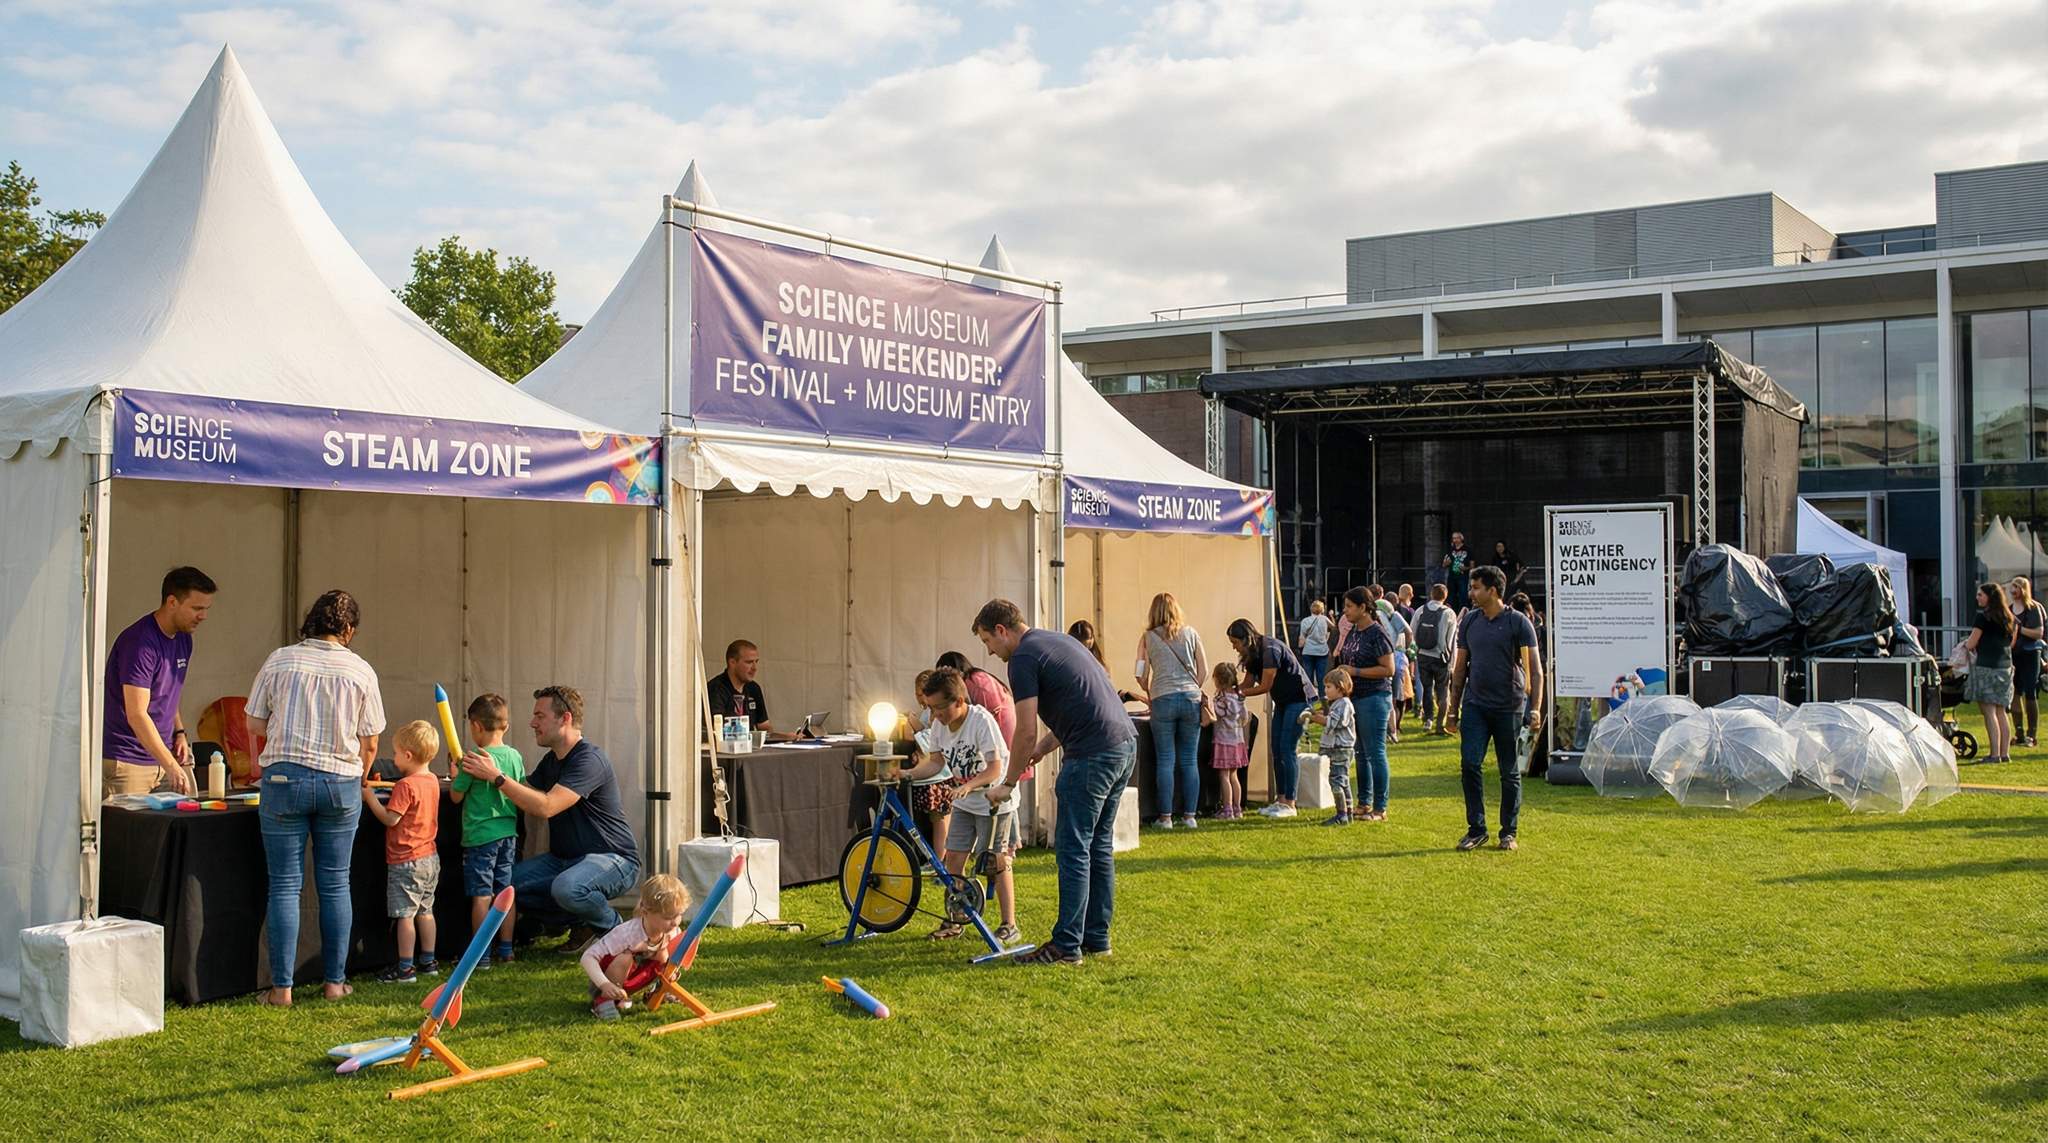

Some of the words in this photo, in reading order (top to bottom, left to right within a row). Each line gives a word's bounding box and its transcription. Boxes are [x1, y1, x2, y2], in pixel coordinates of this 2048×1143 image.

[779, 281, 887, 331] SCIENCE
[894, 302, 989, 348] MUSEUM
[762, 320, 854, 365] FAMILY
[859, 336, 1003, 387] WEEKENDER:
[716, 357, 836, 405] FESTIVAL
[843, 382, 857, 401] +
[866, 378, 963, 420] MUSEUM
[970, 392, 1032, 427] ENTRY
[134, 412, 233, 440] SCIENCE
[134, 437, 237, 464] MUSEUM
[322, 430, 439, 473] STEAM
[450, 440, 531, 479] ZONE
[1071, 501, 1111, 516] MUSEUM
[1138, 495, 1183, 518] STEAM
[1187, 498, 1222, 521] ZONE
[1559, 544, 1624, 558] WEATHER
[1560, 558, 1657, 572] CONTINGENCY
[1560, 573, 1596, 586] PLAN
